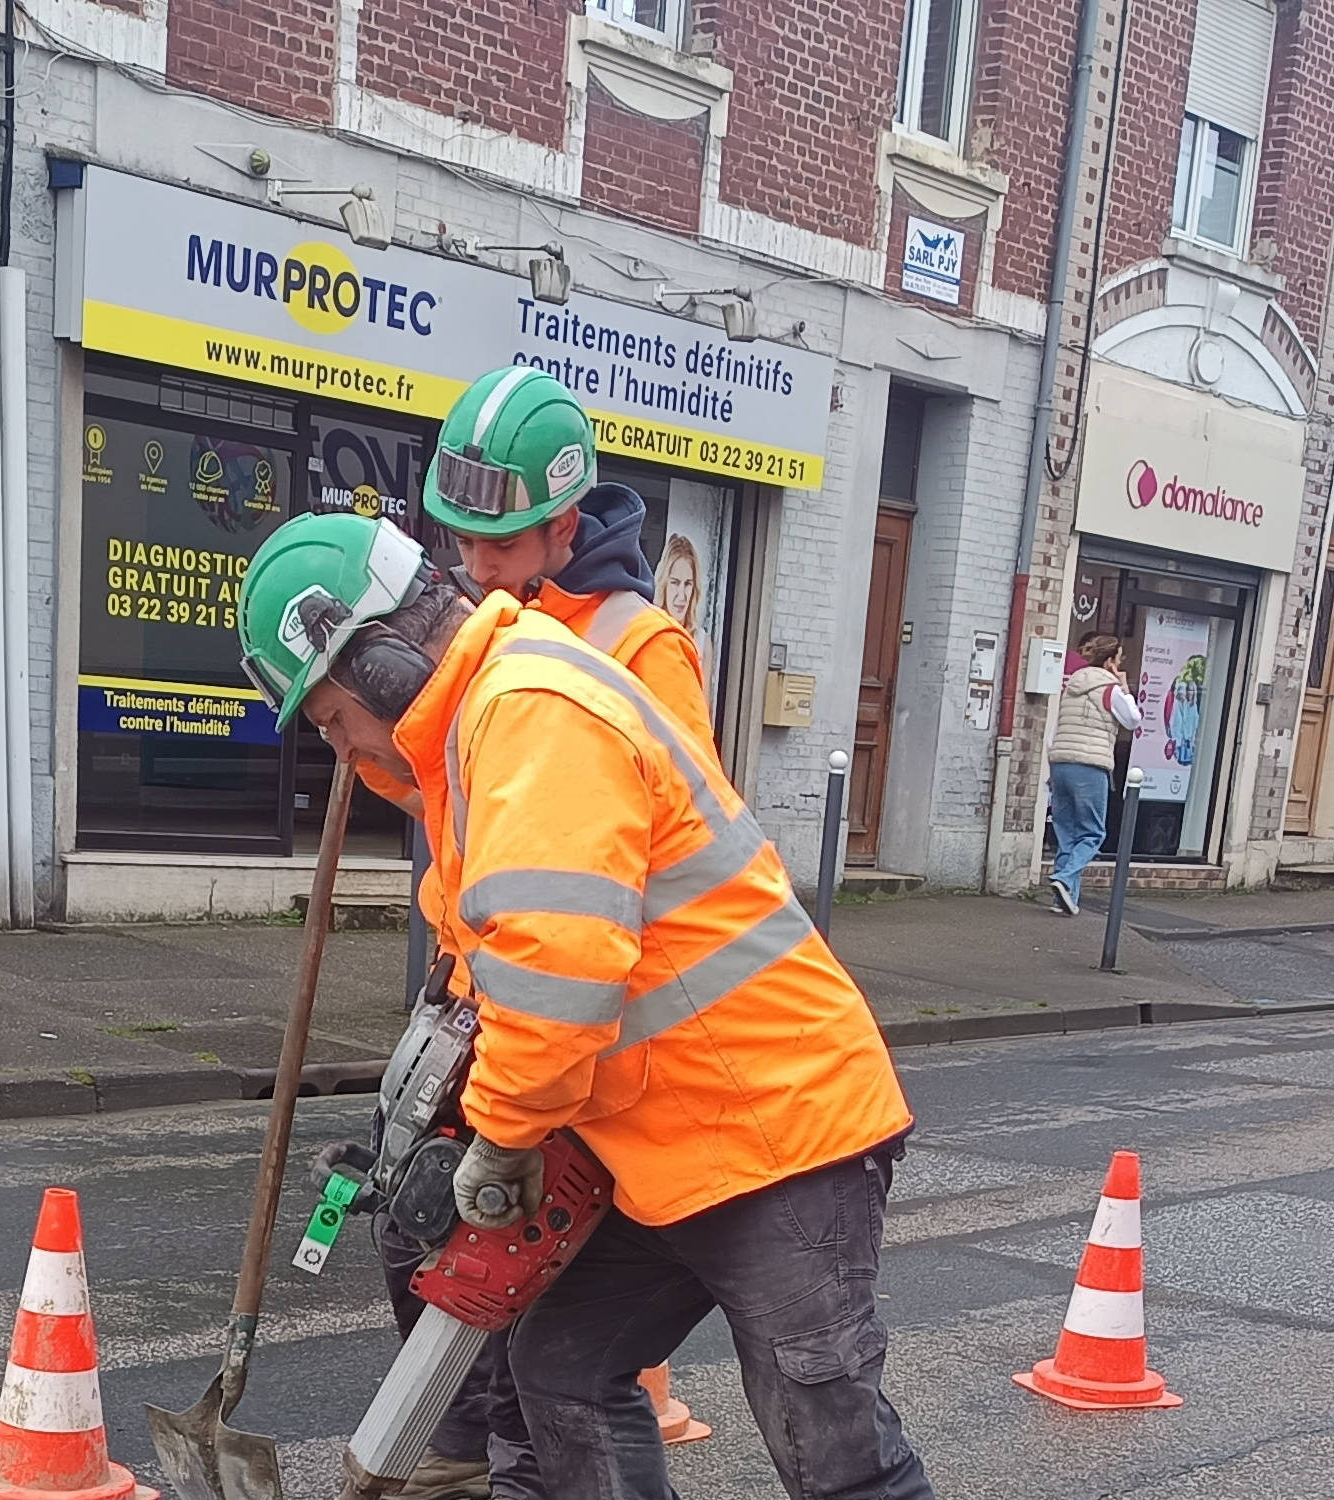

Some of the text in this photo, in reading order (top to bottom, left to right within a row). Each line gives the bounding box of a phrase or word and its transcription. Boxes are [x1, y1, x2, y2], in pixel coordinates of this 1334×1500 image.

[908, 245, 958, 274] SARL PJY
[186, 234, 436, 336] MURPROTEC
[516, 297, 794, 396] Traitements définitifs
[205, 340, 415, 402] www.murprotec.fr
[621, 425, 694, 459] GRATUIT
[699, 440, 719, 464] 03
[722, 445, 741, 469] 22
[744, 449, 764, 472] 39
[767, 454, 783, 476] 21
[788, 458, 805, 481] 51
[321, 486, 407, 515] MURPROTEC
[1161, 475, 1264, 528] domaliance
[108, 538, 248, 579] DIAGNOSTIC
[108, 566, 211, 600] GRATUIT
[107, 593, 132, 617] 03
[137, 597, 161, 621] 22
[167, 601, 190, 624] 39
[195, 604, 216, 627] 21
[104, 690, 246, 718] Traitements définitifs
[119, 715, 231, 737] contre l'humidité
